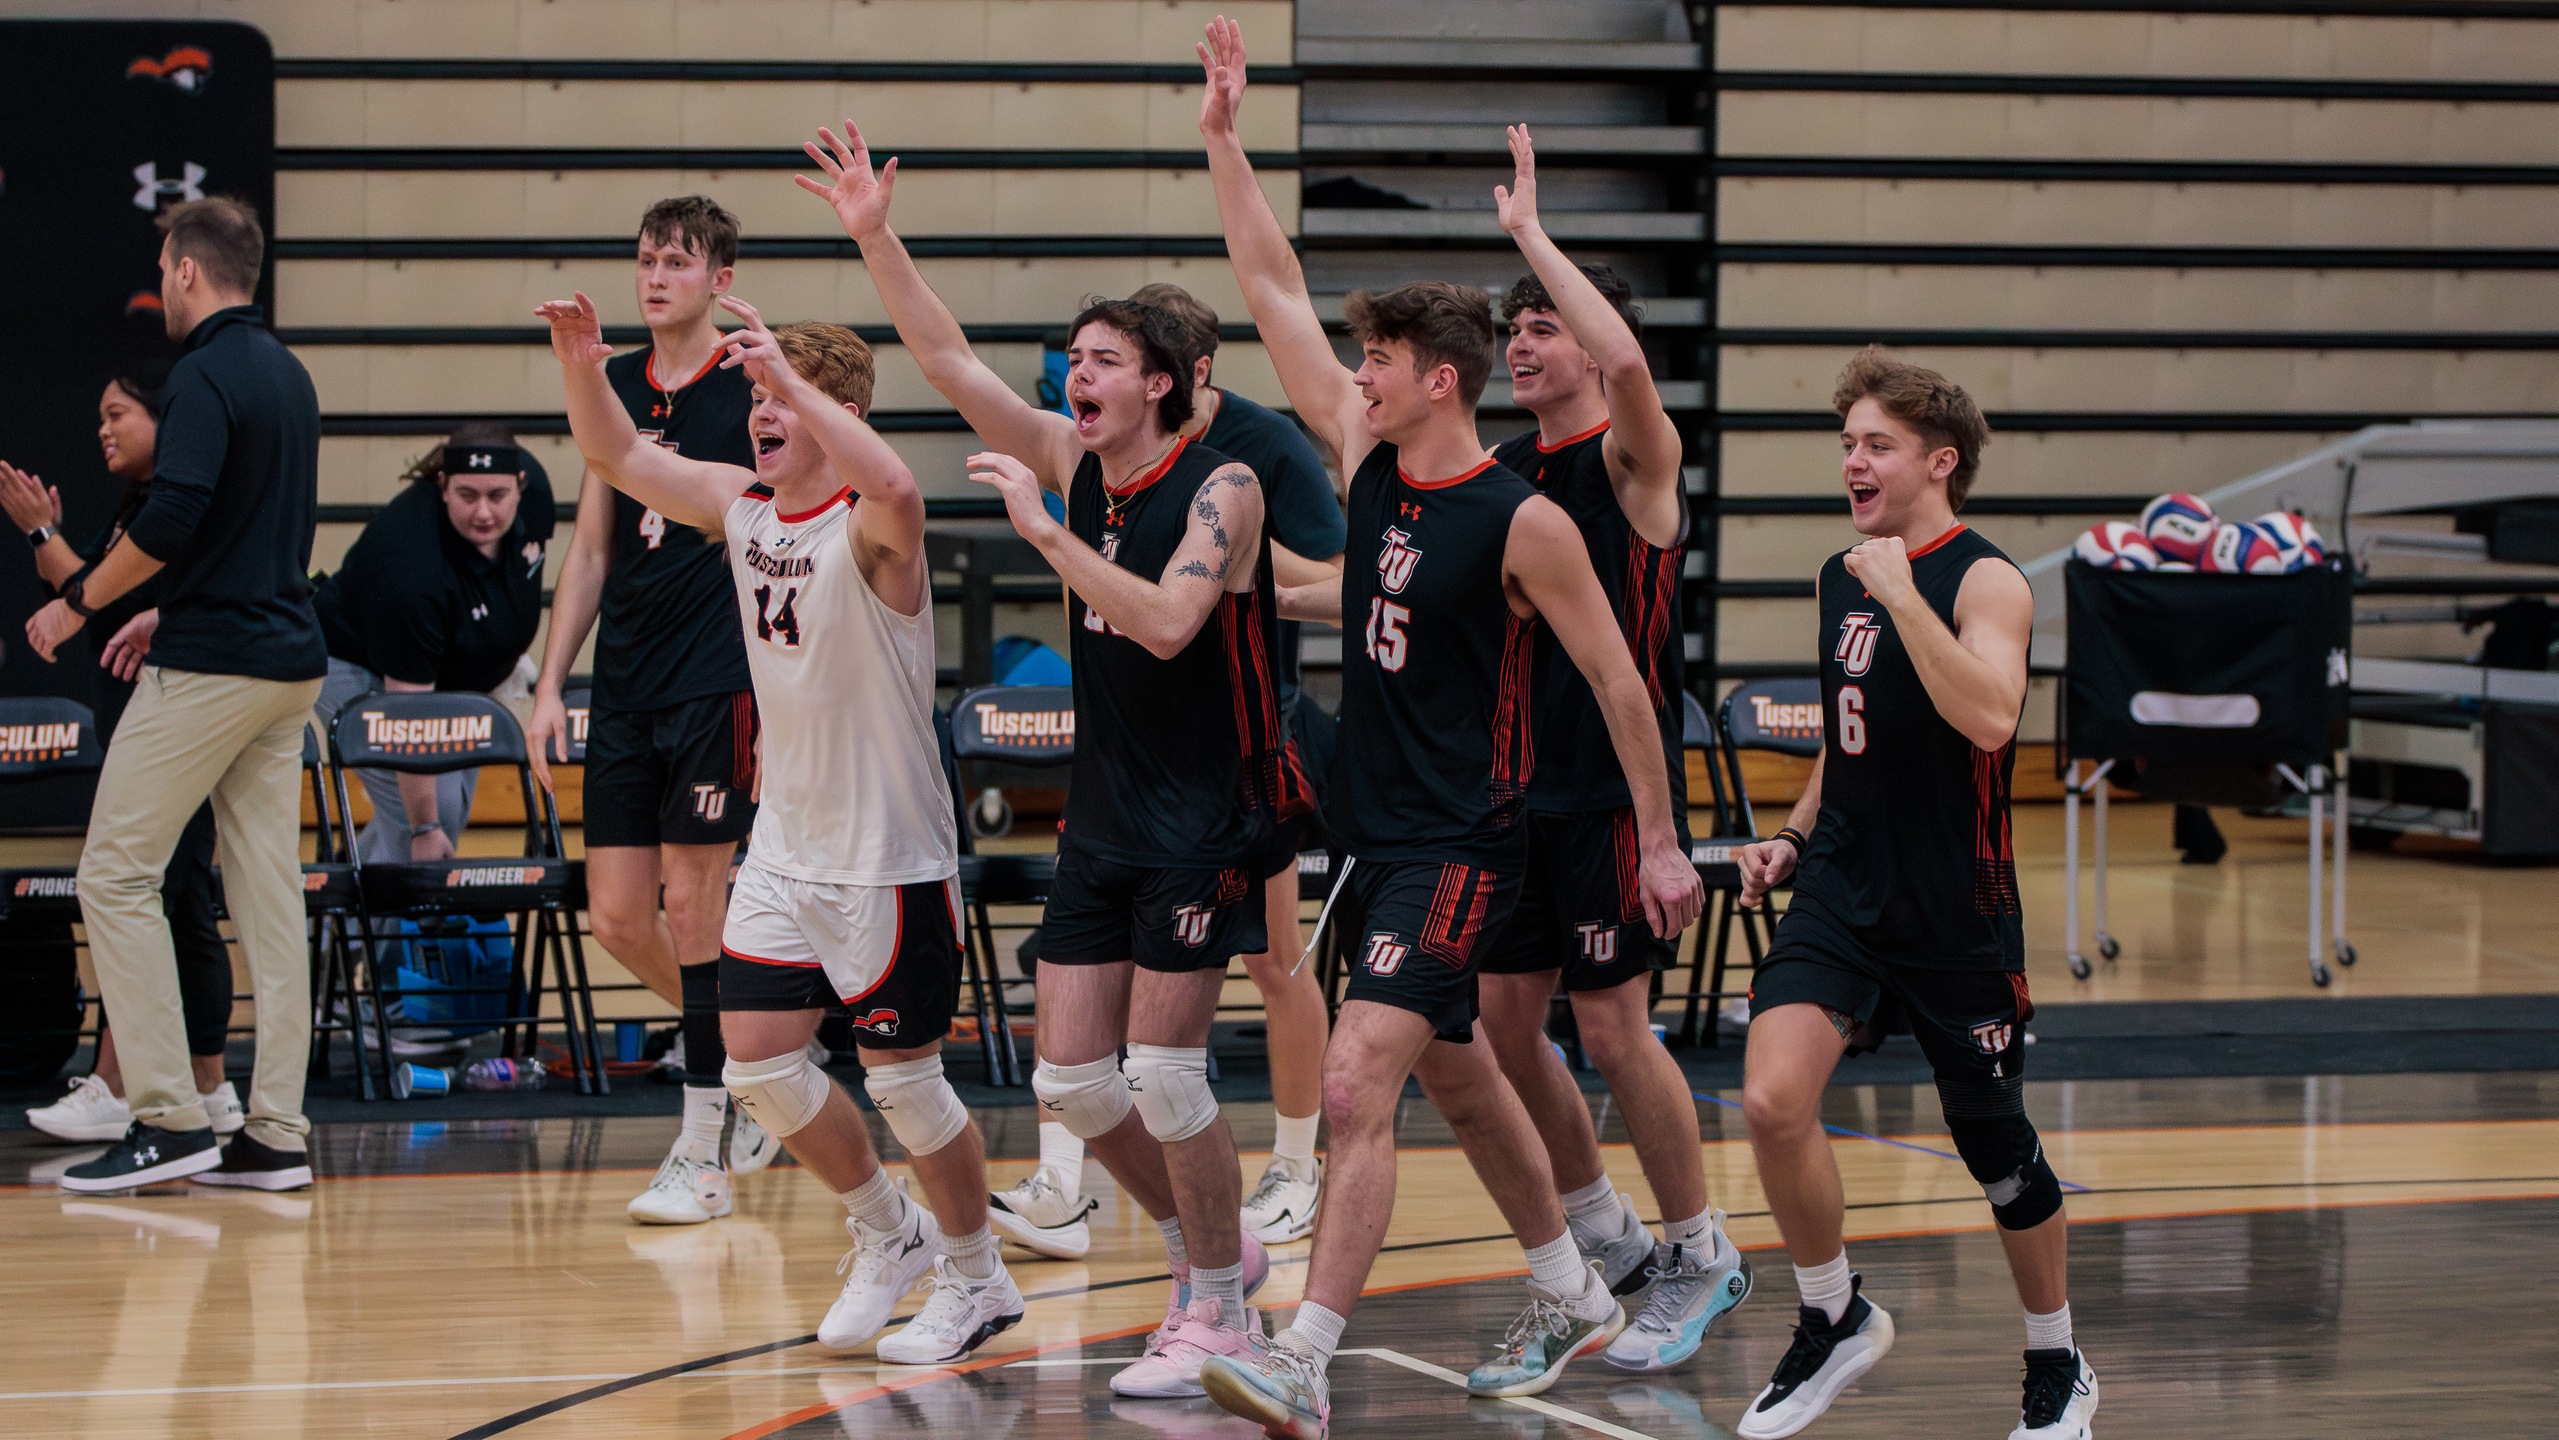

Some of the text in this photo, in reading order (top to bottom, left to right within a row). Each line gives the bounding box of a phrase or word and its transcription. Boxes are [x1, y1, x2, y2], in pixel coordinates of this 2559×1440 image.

[639, 507, 666, 550] 4
[1377, 525, 1423, 594] TU
[754, 583, 800, 647] 14
[1366, 596, 1411, 673] 15
[1835, 612, 1881, 677] TU
[361, 711, 493, 745] TUSCULUM
[1750, 695, 1824, 728] TUSCU
[1838, 685, 1867, 756] 6
[690, 781, 731, 823] TU
[1172, 901, 1216, 948] TU
[1574, 919, 1618, 966] TU
[1363, 931, 1411, 977] TU
